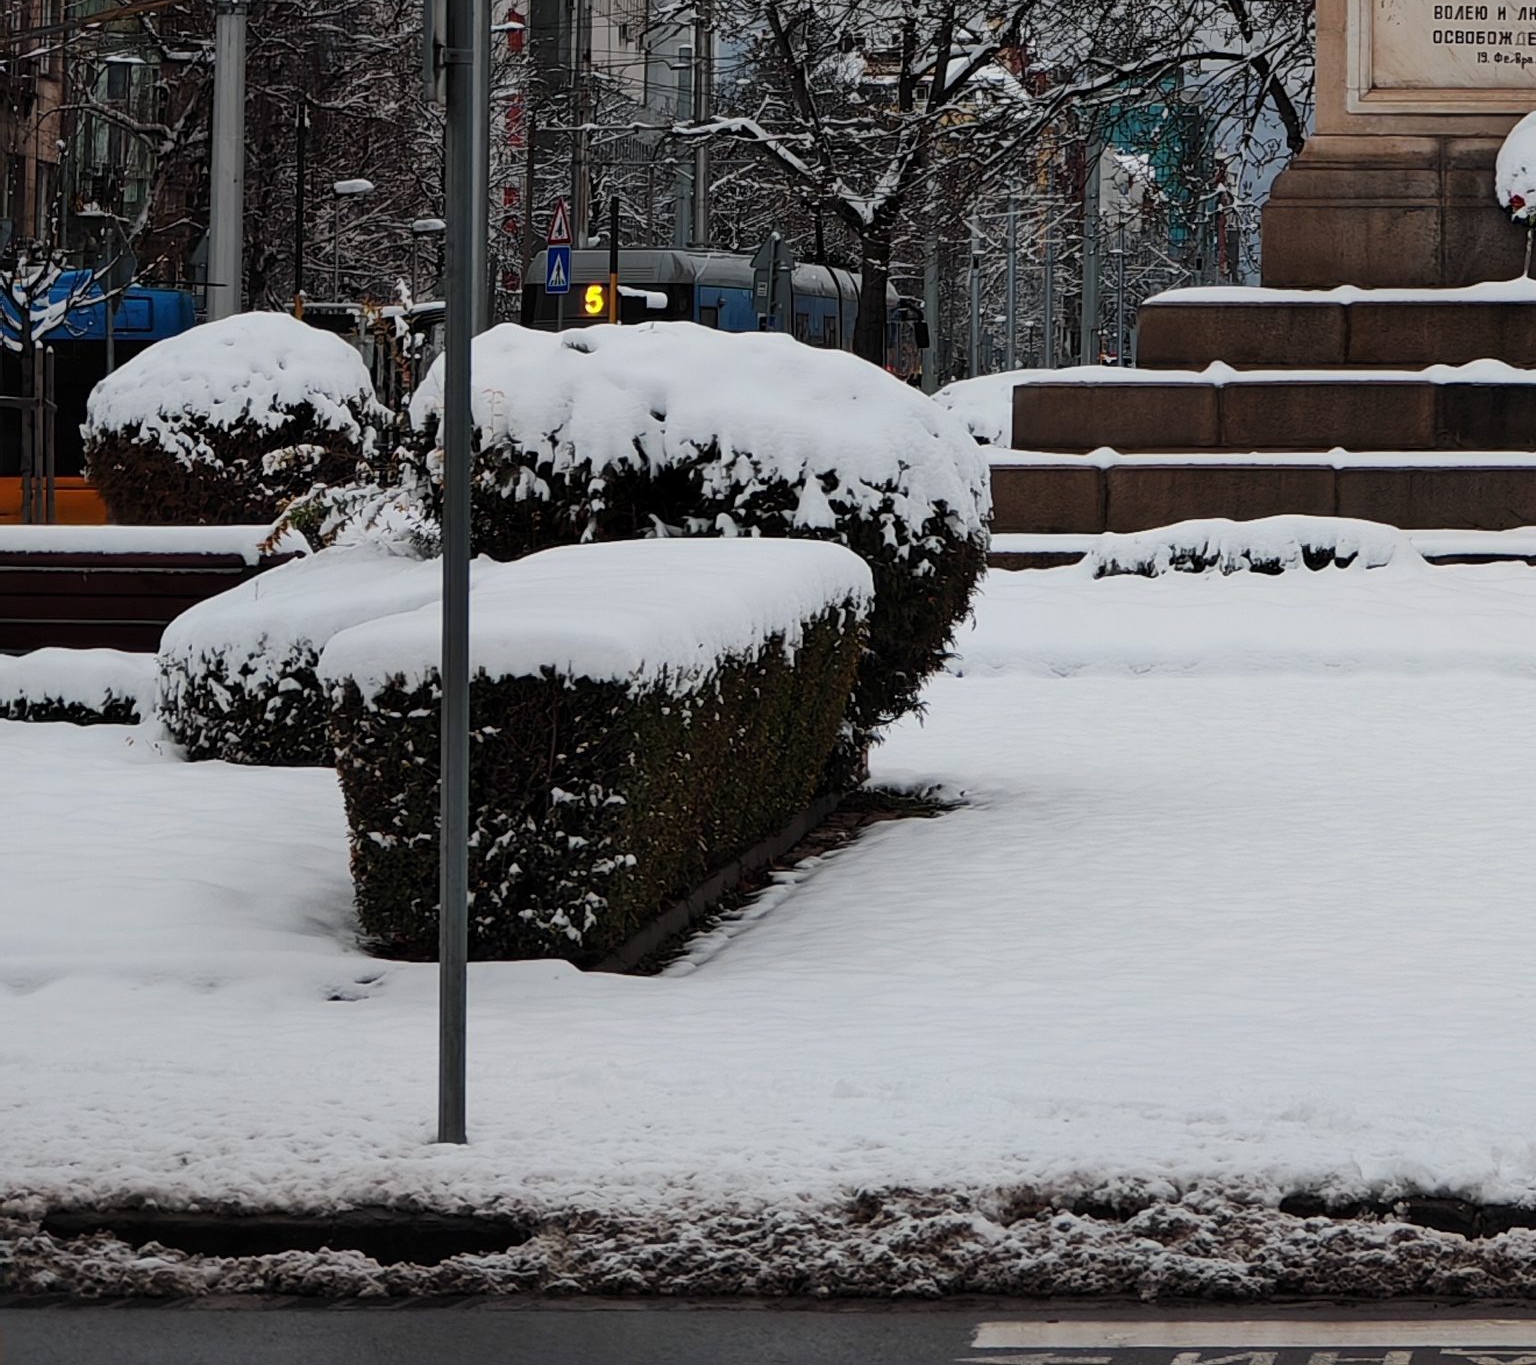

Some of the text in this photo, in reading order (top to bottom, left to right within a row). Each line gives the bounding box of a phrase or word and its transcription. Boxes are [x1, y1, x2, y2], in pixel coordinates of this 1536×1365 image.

[1434, 5, 1488, 20] ВОЛЕЮ
[1497, 6, 1506, 21] И
[585, 284, 604, 314] 5
